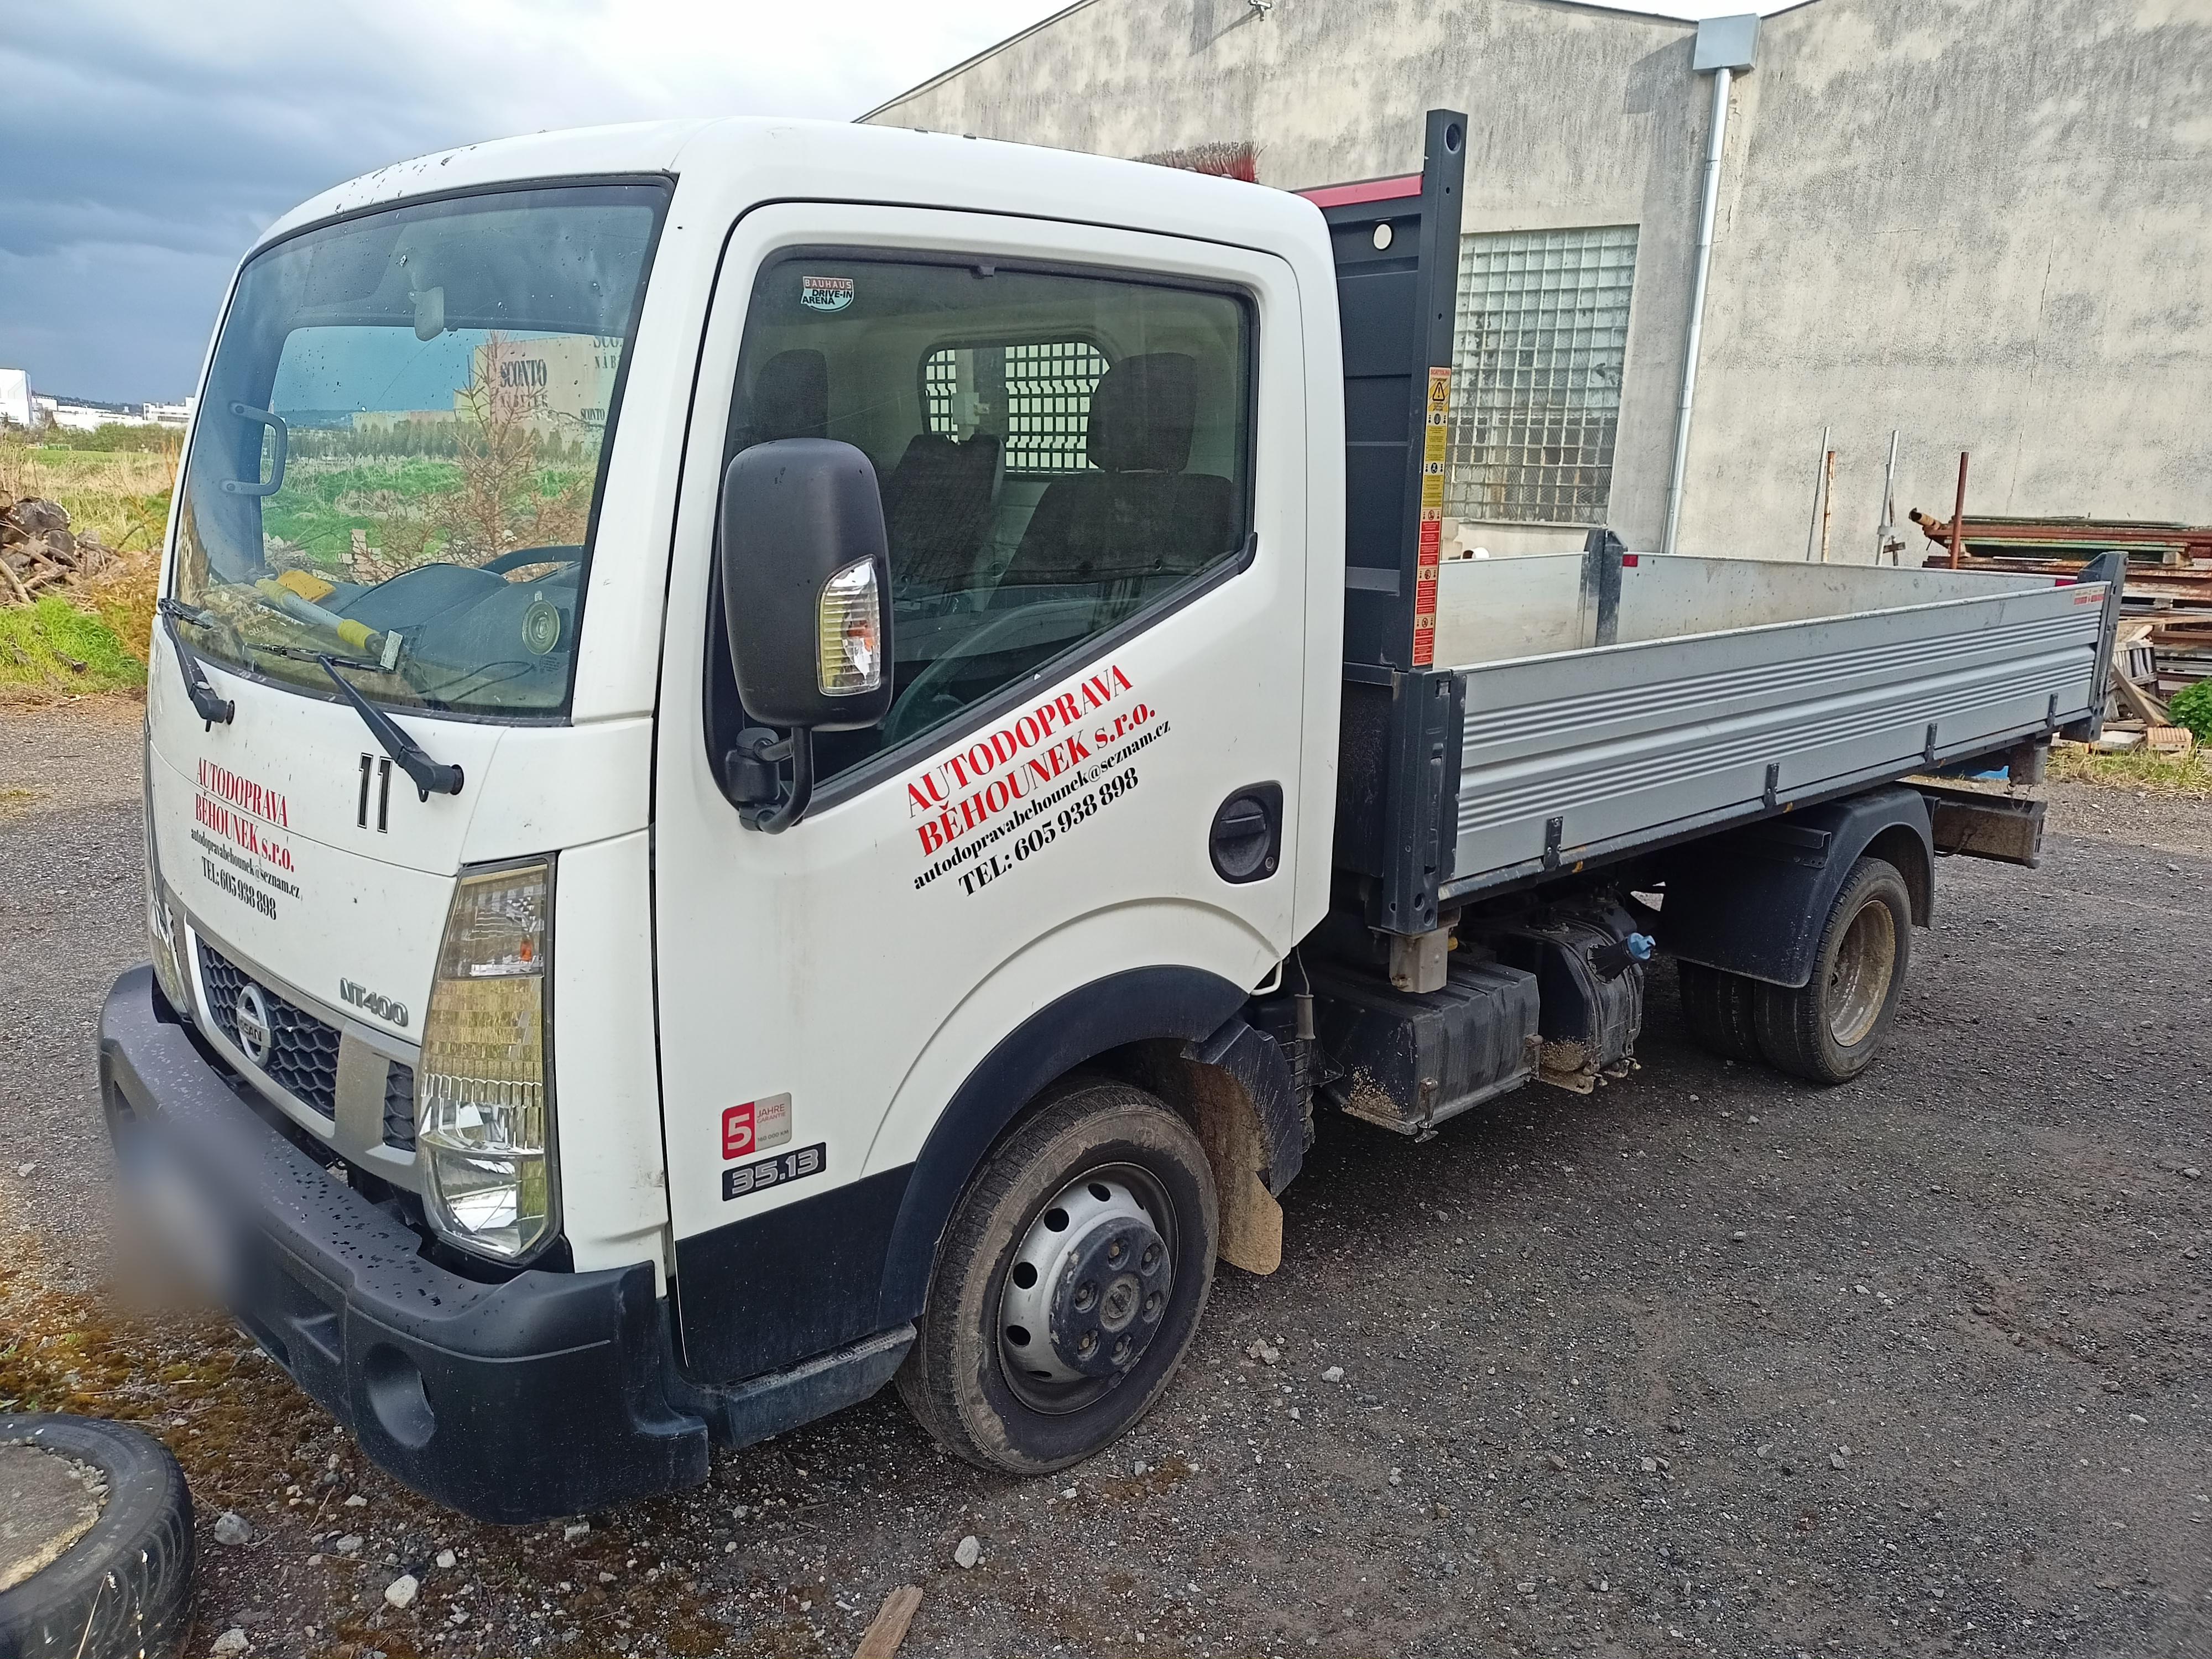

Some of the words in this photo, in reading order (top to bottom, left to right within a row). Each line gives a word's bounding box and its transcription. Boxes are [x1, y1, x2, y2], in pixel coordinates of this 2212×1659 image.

[802, 296, 835, 305] ARENA
[805, 279, 852, 289] BAUHAUS
[812, 289, 853, 298] DRIVE-IN
[500, 359, 547, 388] SCONTO
[906, 665, 1133, 818] AUTODOPRAVA
[196, 757, 288, 828] AUTODOPRAVA
[357, 752, 393, 833] 11
[914, 719, 1171, 889] autodopravabehounek@seznam.cz
[916, 730, 1092, 857] BĚHOUNEK
[1094, 703, 1155, 750] s.r.o.
[195, 790, 259, 855] BĚHOUNEK
[261, 838, 294, 873] s.r.o.
[958, 855, 1013, 896] TEL:
[1014, 820, 1056, 862] 605
[1057, 794, 1098, 833] 938
[1099, 767, 1139, 806] 898
[191, 828, 300, 899] autodopravabehounek@seznam.cz
[201, 856, 220, 886] TEL:
[221, 869, 237, 896] 605
[238, 879, 255, 909] 938
[257, 890, 276, 920] 898
[340, 977, 408, 1027] NT400
[238, 1018, 262, 1042] SAN
[727, 1113, 752, 1150] 5
[757, 1103, 785, 1118] JAHRE
[757, 1112, 786, 1124] GARANTIE
[732, 1149, 818, 1194] 35.13
